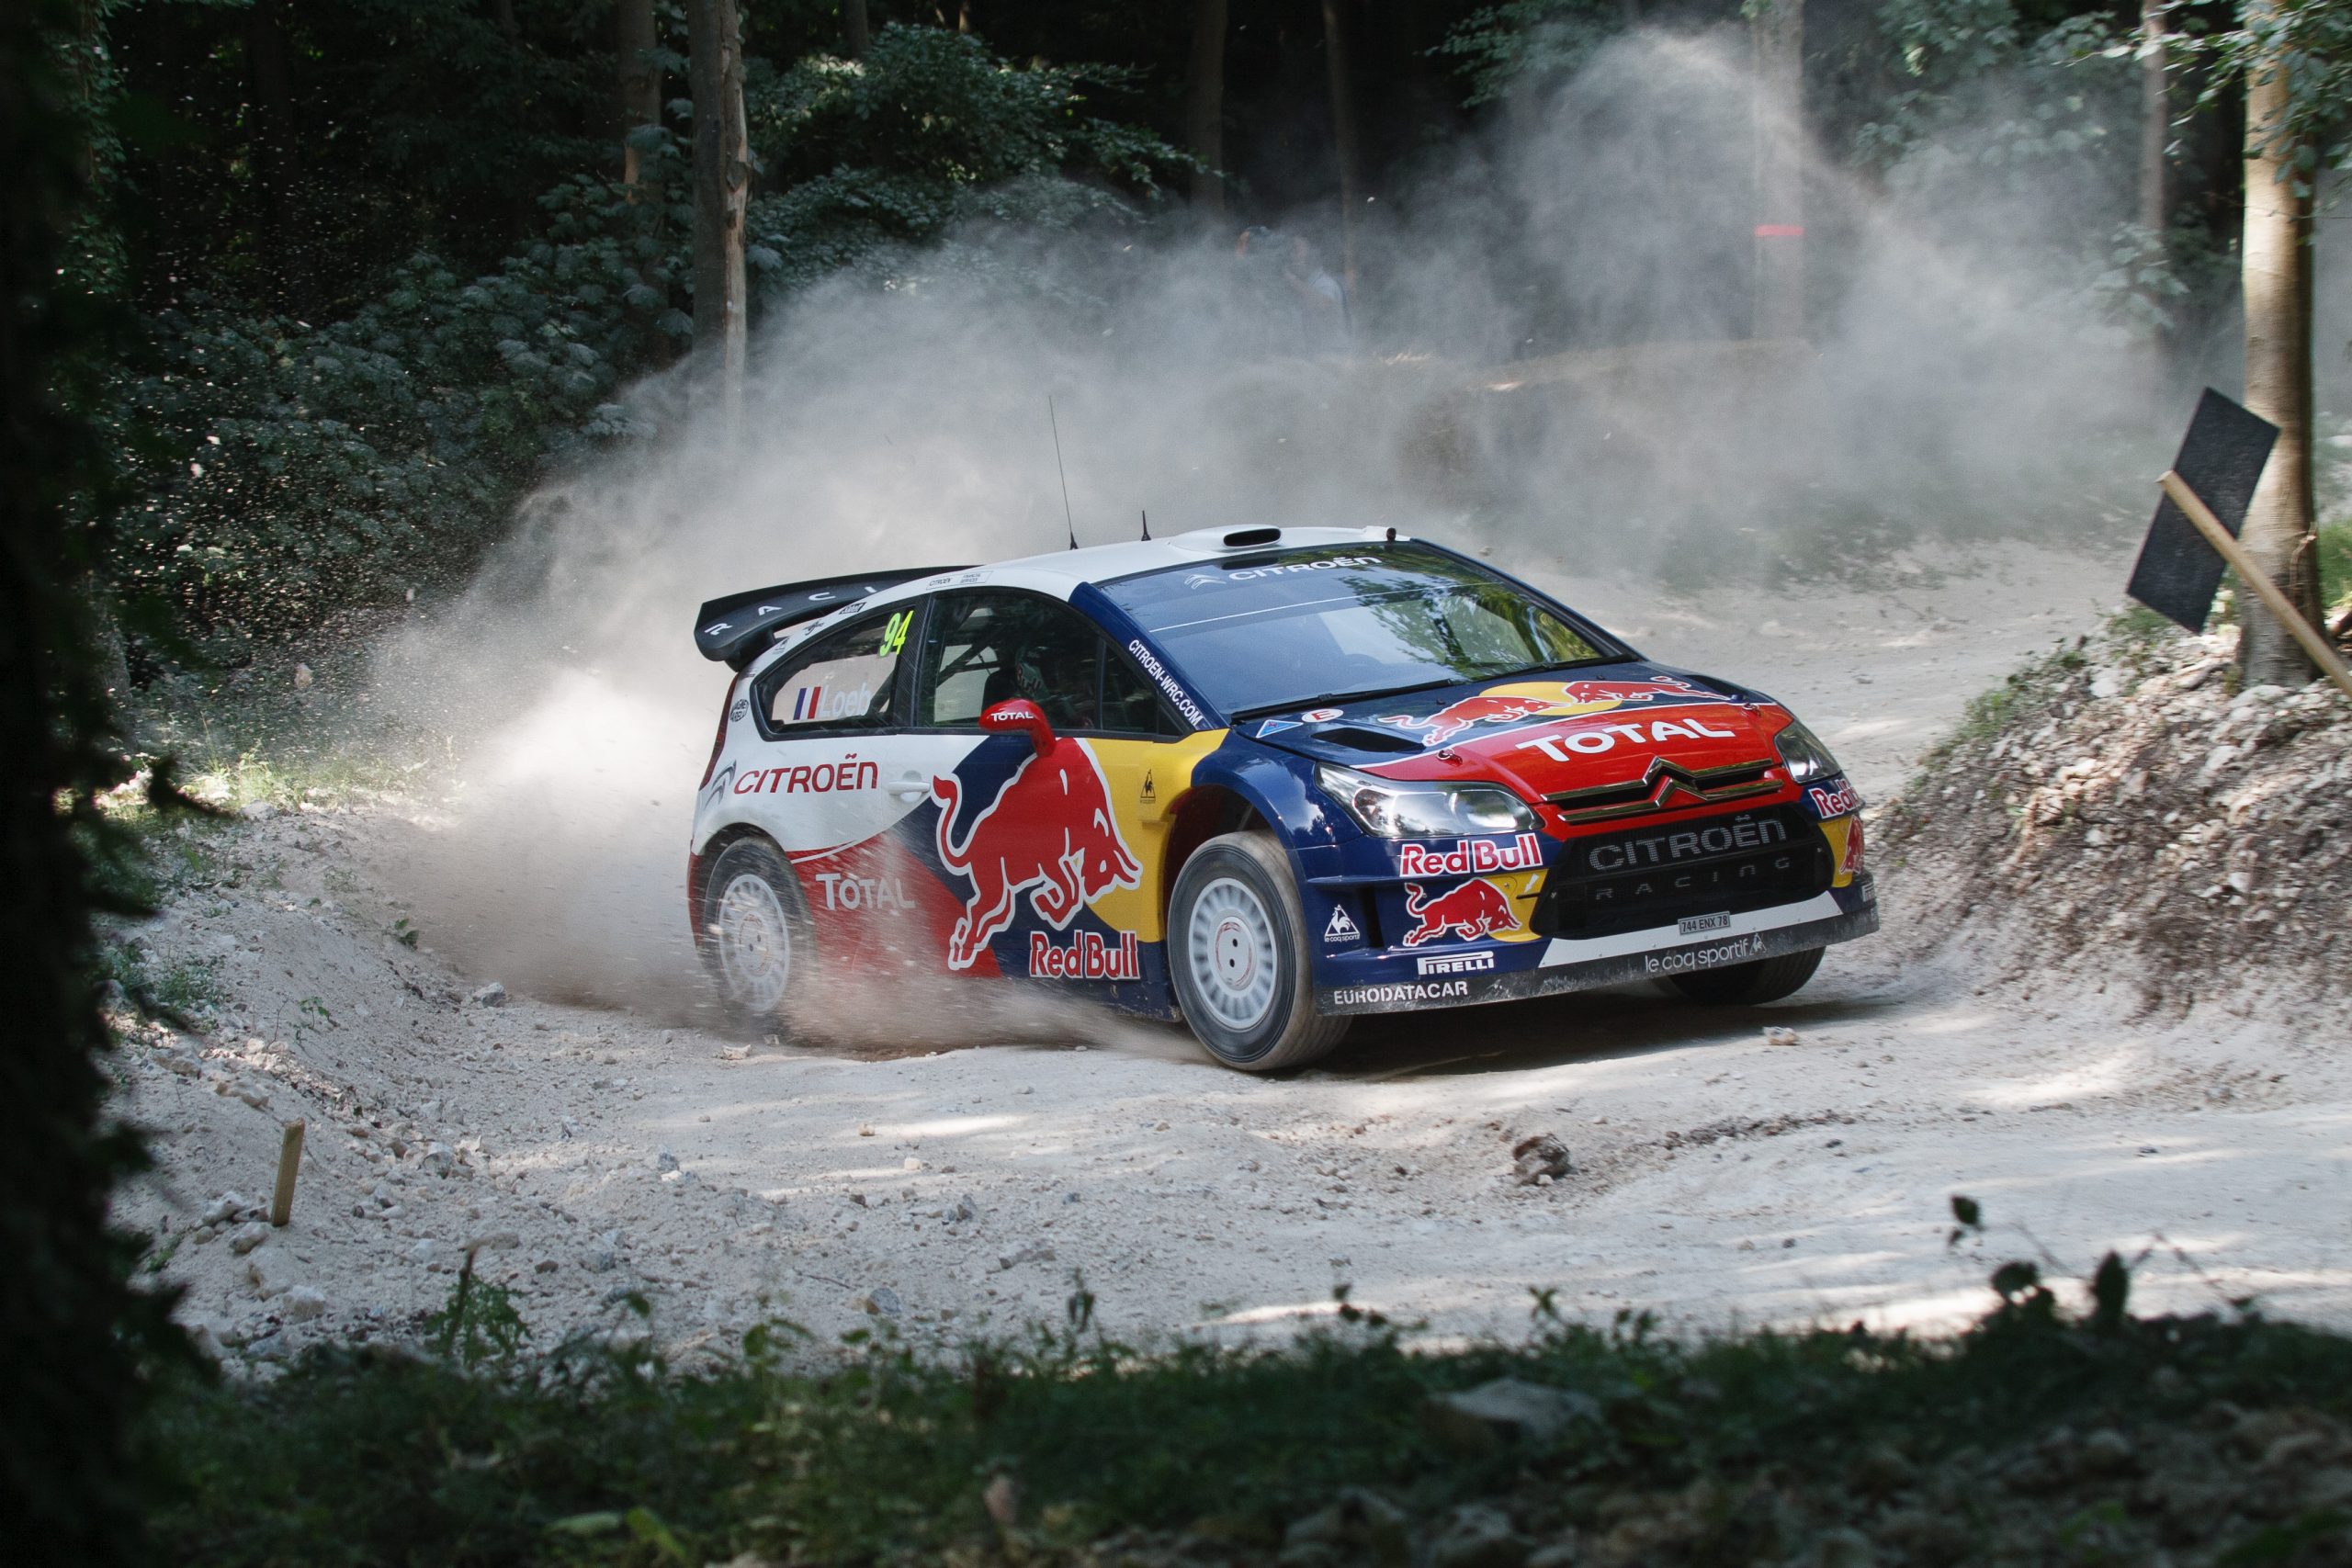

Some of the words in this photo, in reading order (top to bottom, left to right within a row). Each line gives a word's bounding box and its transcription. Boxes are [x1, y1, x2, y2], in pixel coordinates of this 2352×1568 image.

[1228, 557, 1382, 581] CITROËN
[705, 585, 877, 637] RACI
[878, 610, 914, 658] 94
[818, 682, 872, 719] Loeb
[1128, 638, 1204, 728] CITROEN-WRC.COM
[990, 711, 1035, 722] TOTAL
[1311, 710, 1336, 721] E
[1515, 718, 1736, 762] TOTAL
[733, 753, 877, 795] CITROËN
[1399, 840, 1470, 877] Red
[1471, 832, 1544, 873] Bull
[1589, 814, 1786, 870] CITROËN
[815, 873, 917, 910] TOTAL
[1596, 857, 1790, 900] RACING
[1699, 918, 1716, 930] ENX
[1717, 915, 1728, 927] 78
[1030, 930, 1083, 978] Red
[1084, 931, 1140, 980] Bull
[1417, 951, 1495, 976] PIRELLI
[1645, 954, 1659, 973] le
[1662, 952, 1695, 970] coq
[1698, 938, 1748, 968] sportif
[1333, 981, 1468, 1005] EURODATACAR
